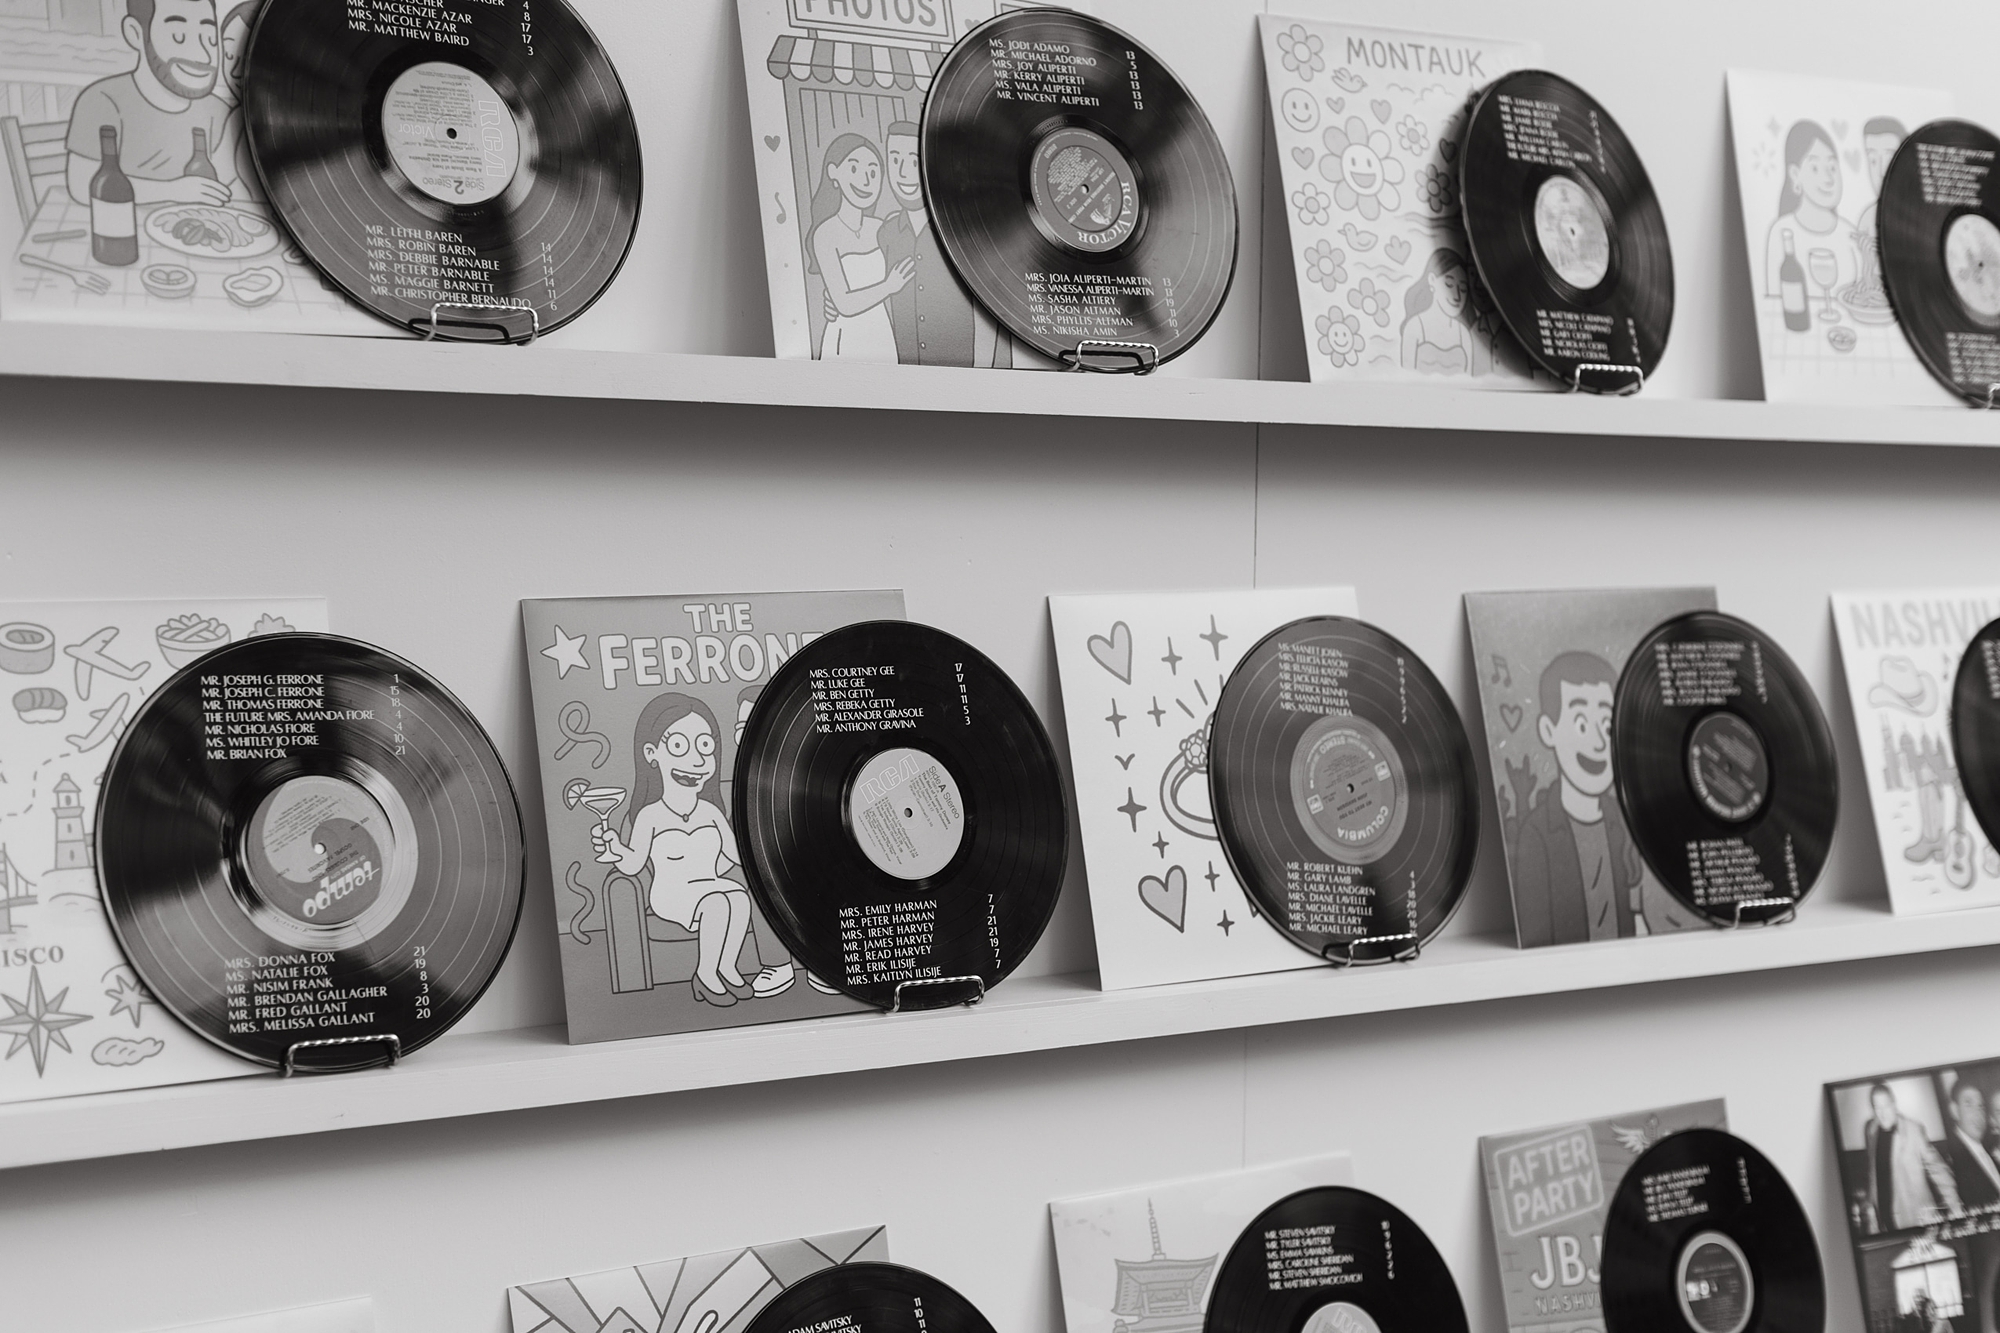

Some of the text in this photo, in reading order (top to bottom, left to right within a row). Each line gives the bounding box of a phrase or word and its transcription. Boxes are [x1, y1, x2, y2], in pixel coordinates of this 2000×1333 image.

[347, 0, 531, 32] MR. MACKENZIE AZAR 17
[348, 9, 531, 44] MRS. NICOLE AZAR 17
[349, 20, 533, 55] MR. MATTHEW BAIRD 3
[989, 39, 1135, 59] MS. JODI ADAMO 13
[991, 49, 1008, 58] MR.
[1011, 51, 1051, 62] MICHAEL
[1055, 55, 1097, 66] ADORNO
[1347, 36, 1486, 78] MONTAUK
[997, 90, 1143, 110] MR. VINCENT ALIPERTI 13
[399, 124, 434, 138] Victor
[423, 177, 484, 194] Side 2 Stereo
[1121, 182, 1132, 215] RCA
[1077, 219, 1131, 244] VICTOR
[366, 237, 552, 263] MRS. ROBIN BAREN 14
[368, 261, 390, 272] MR.
[394, 263, 427, 275] PETER
[432, 267, 489, 281] BARNABLE
[1025, 273, 1171, 286] MRS. JOIA ALIPERTI-MARTIN 13
[370, 274, 390, 284] MS.
[394, 276, 440, 288] MAGGIE
[444, 280, 494, 293] BARNETT
[1028, 294, 1174, 307] MS. SASHA ALTIERY 19
[1030, 304, 1048, 313] MR.
[1050, 305, 1081, 316] JASON
[1084, 306, 1121, 315] ALTMAN
[682, 602, 753, 633] THE
[201, 674, 398, 685] MR. JOSEPH G. FERRONE 1
[810, 669, 831, 678] MRS.
[832, 667, 878, 677] COURTNEY
[879, 666, 895, 675] GEE
[204, 709, 401, 722] THE FUTURE MRS. AMANDA FIORE 4
[815, 713, 832, 722] MR.
[834, 710, 882, 721] ALEXANDER
[883, 708, 924, 718] GIRASOLE
[816, 716, 970, 733] MR. ANTHONY GRAVINA 3
[206, 734, 403, 748] MS. WHITLEY JO FORE 10
[928, 766, 959, 819] Side A Stereo
[1337, 806, 1389, 840] COLUMBIA
[1287, 872, 1352, 884] MR. GARY LAMB
[302, 861, 380, 917] tempo
[839, 894, 993, 917] MRS. EMILY HARMAN 7
[1288, 902, 1302, 911] MR.
[1306, 904, 1340, 913] MICHAEL
[1342, 906, 1372, 916] LAVELLE
[1289, 923, 1367, 935] MR. MICHAEL LEARY
[843, 928, 998, 951] MR. JAMES HARVEY 21
[845, 938, 998, 962] MR. READ HARVEY 19
[226, 972, 427, 994] MR. NISIM FRANK 8
[228, 984, 428, 1007] MR. BRENDAN GALLAGHER 3
[230, 1010, 430, 1033] MRS. MELISSA GALLANT 20
[1509, 1134, 1591, 1189] AFTER
[1513, 1170, 1594, 1225] PARTY
[815, 1315, 852, 1332] SAVITSKY
[914, 1298, 921, 1306] 11
[914, 1308, 923, 1318] 10
[918, 1319, 926, 1328] 11
